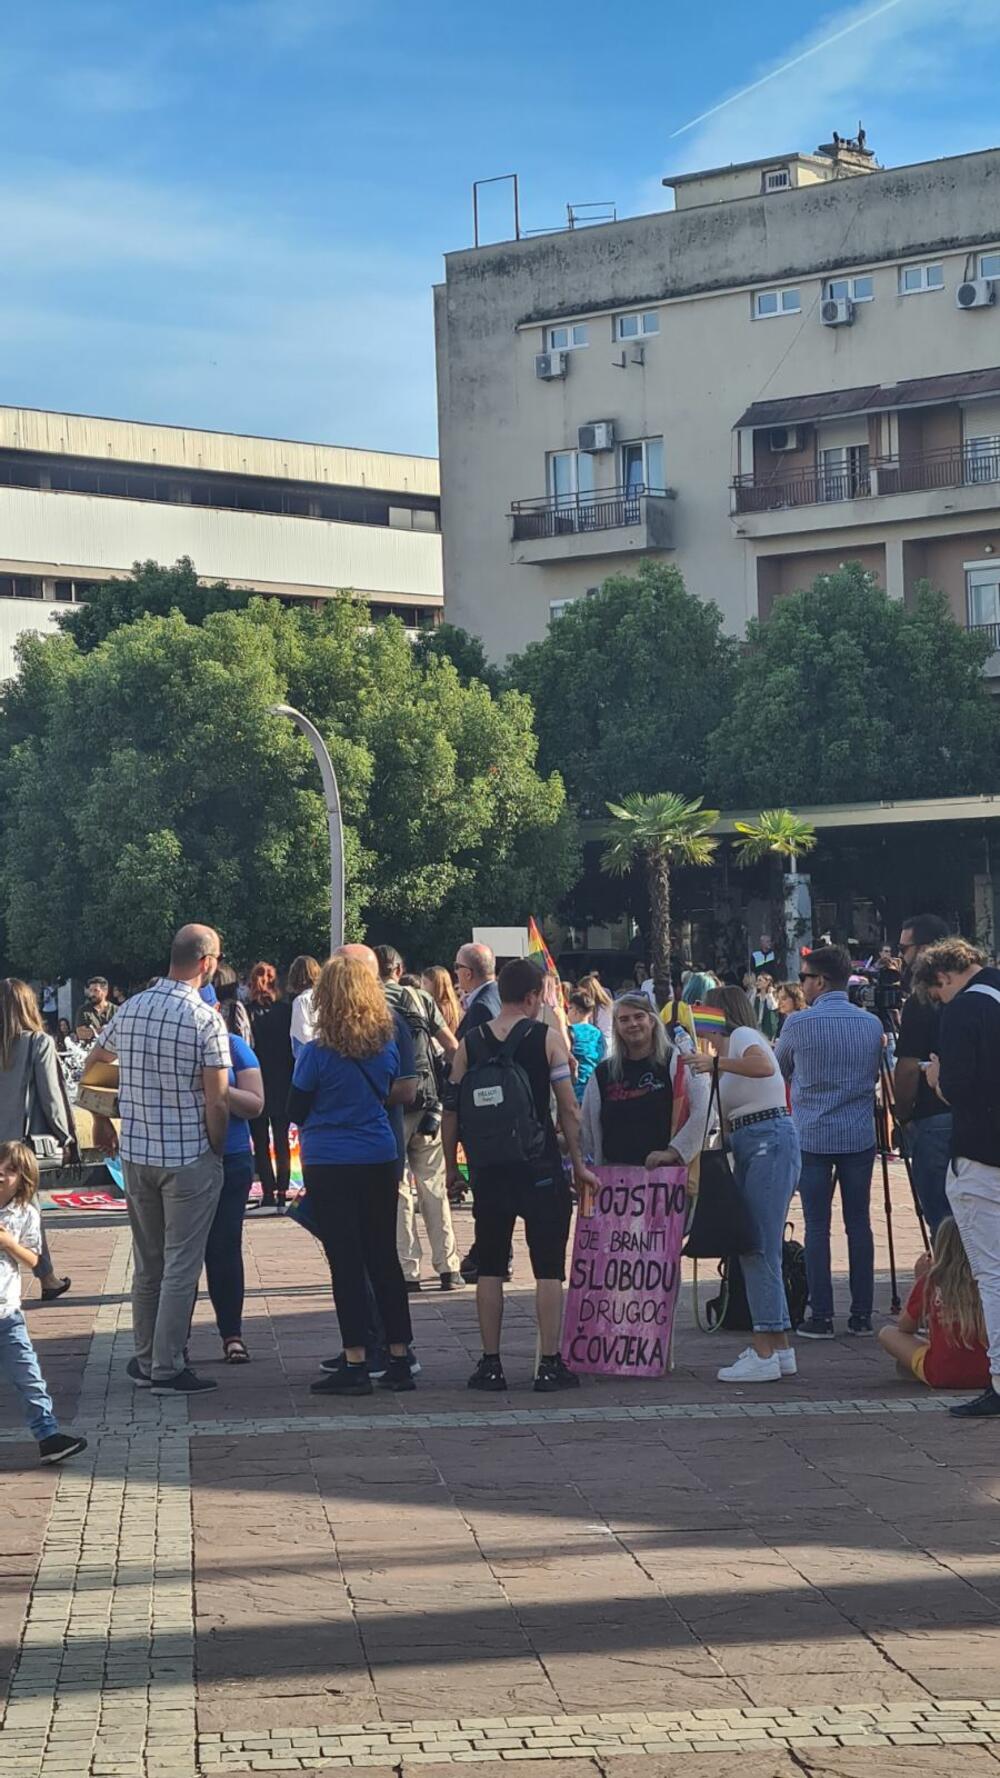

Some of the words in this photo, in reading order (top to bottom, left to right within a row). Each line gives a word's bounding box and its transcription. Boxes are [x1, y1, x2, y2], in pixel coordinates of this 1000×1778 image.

[581, 1178, 686, 1219] OJSTVO
[578, 1224, 600, 1251] JE
[609, 1225, 667, 1254] BRANITI
[571, 1258, 677, 1293] SLOBODU
[579, 1299, 668, 1326] DRUGOG
[569, 1326, 664, 1368] ČOVJEKA
